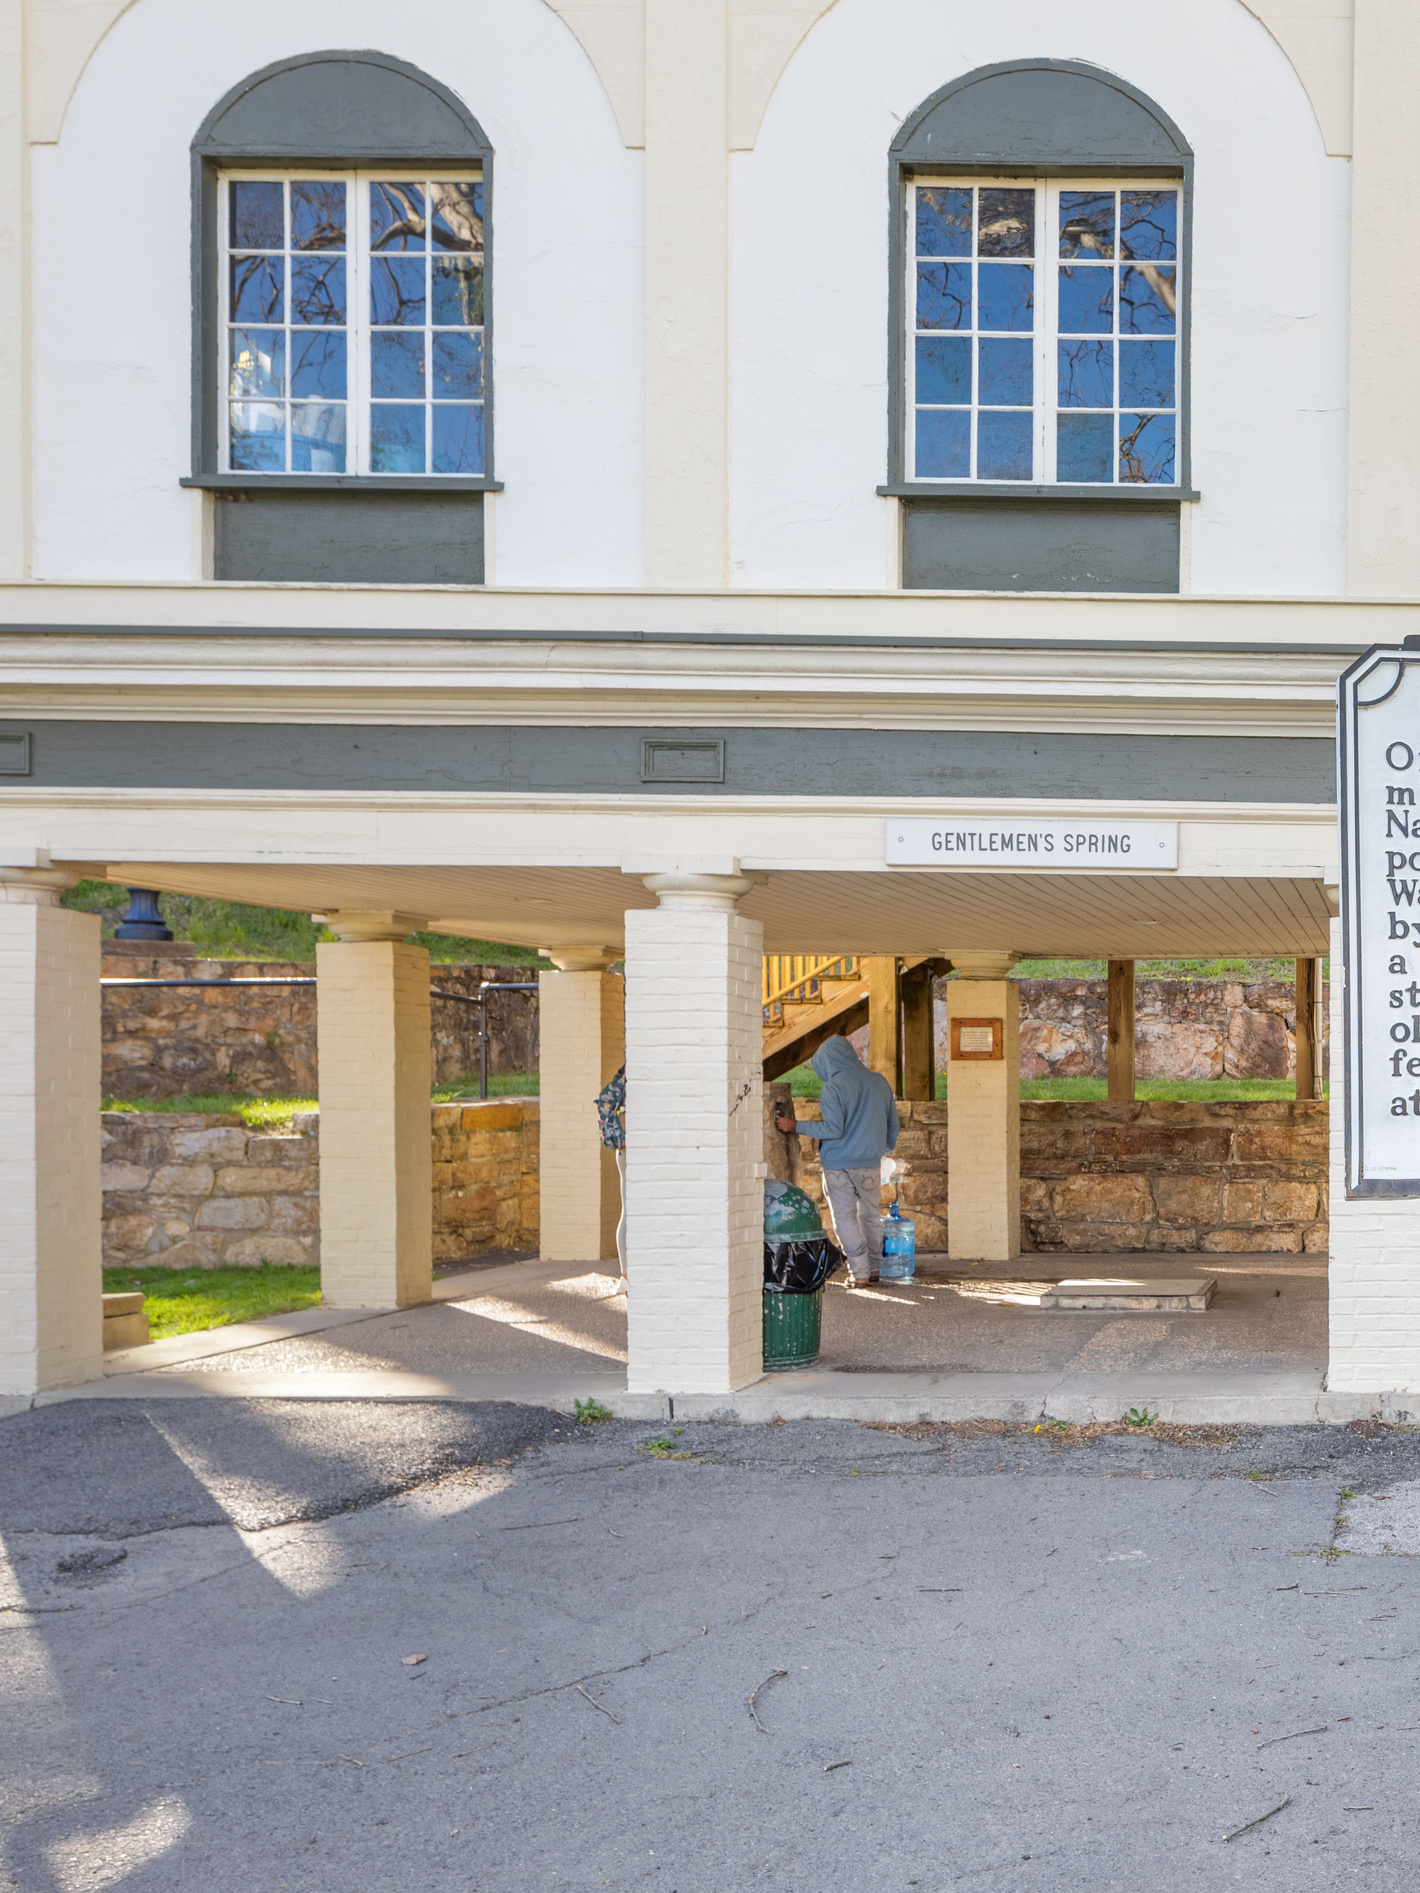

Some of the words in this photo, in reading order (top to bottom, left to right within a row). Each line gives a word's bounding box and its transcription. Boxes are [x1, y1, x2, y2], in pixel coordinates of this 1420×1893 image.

[931, 831, 1055, 853] GENTLEMEN'S
[1063, 833, 1132, 854] SPRING
[1389, 955, 1407, 974] a
